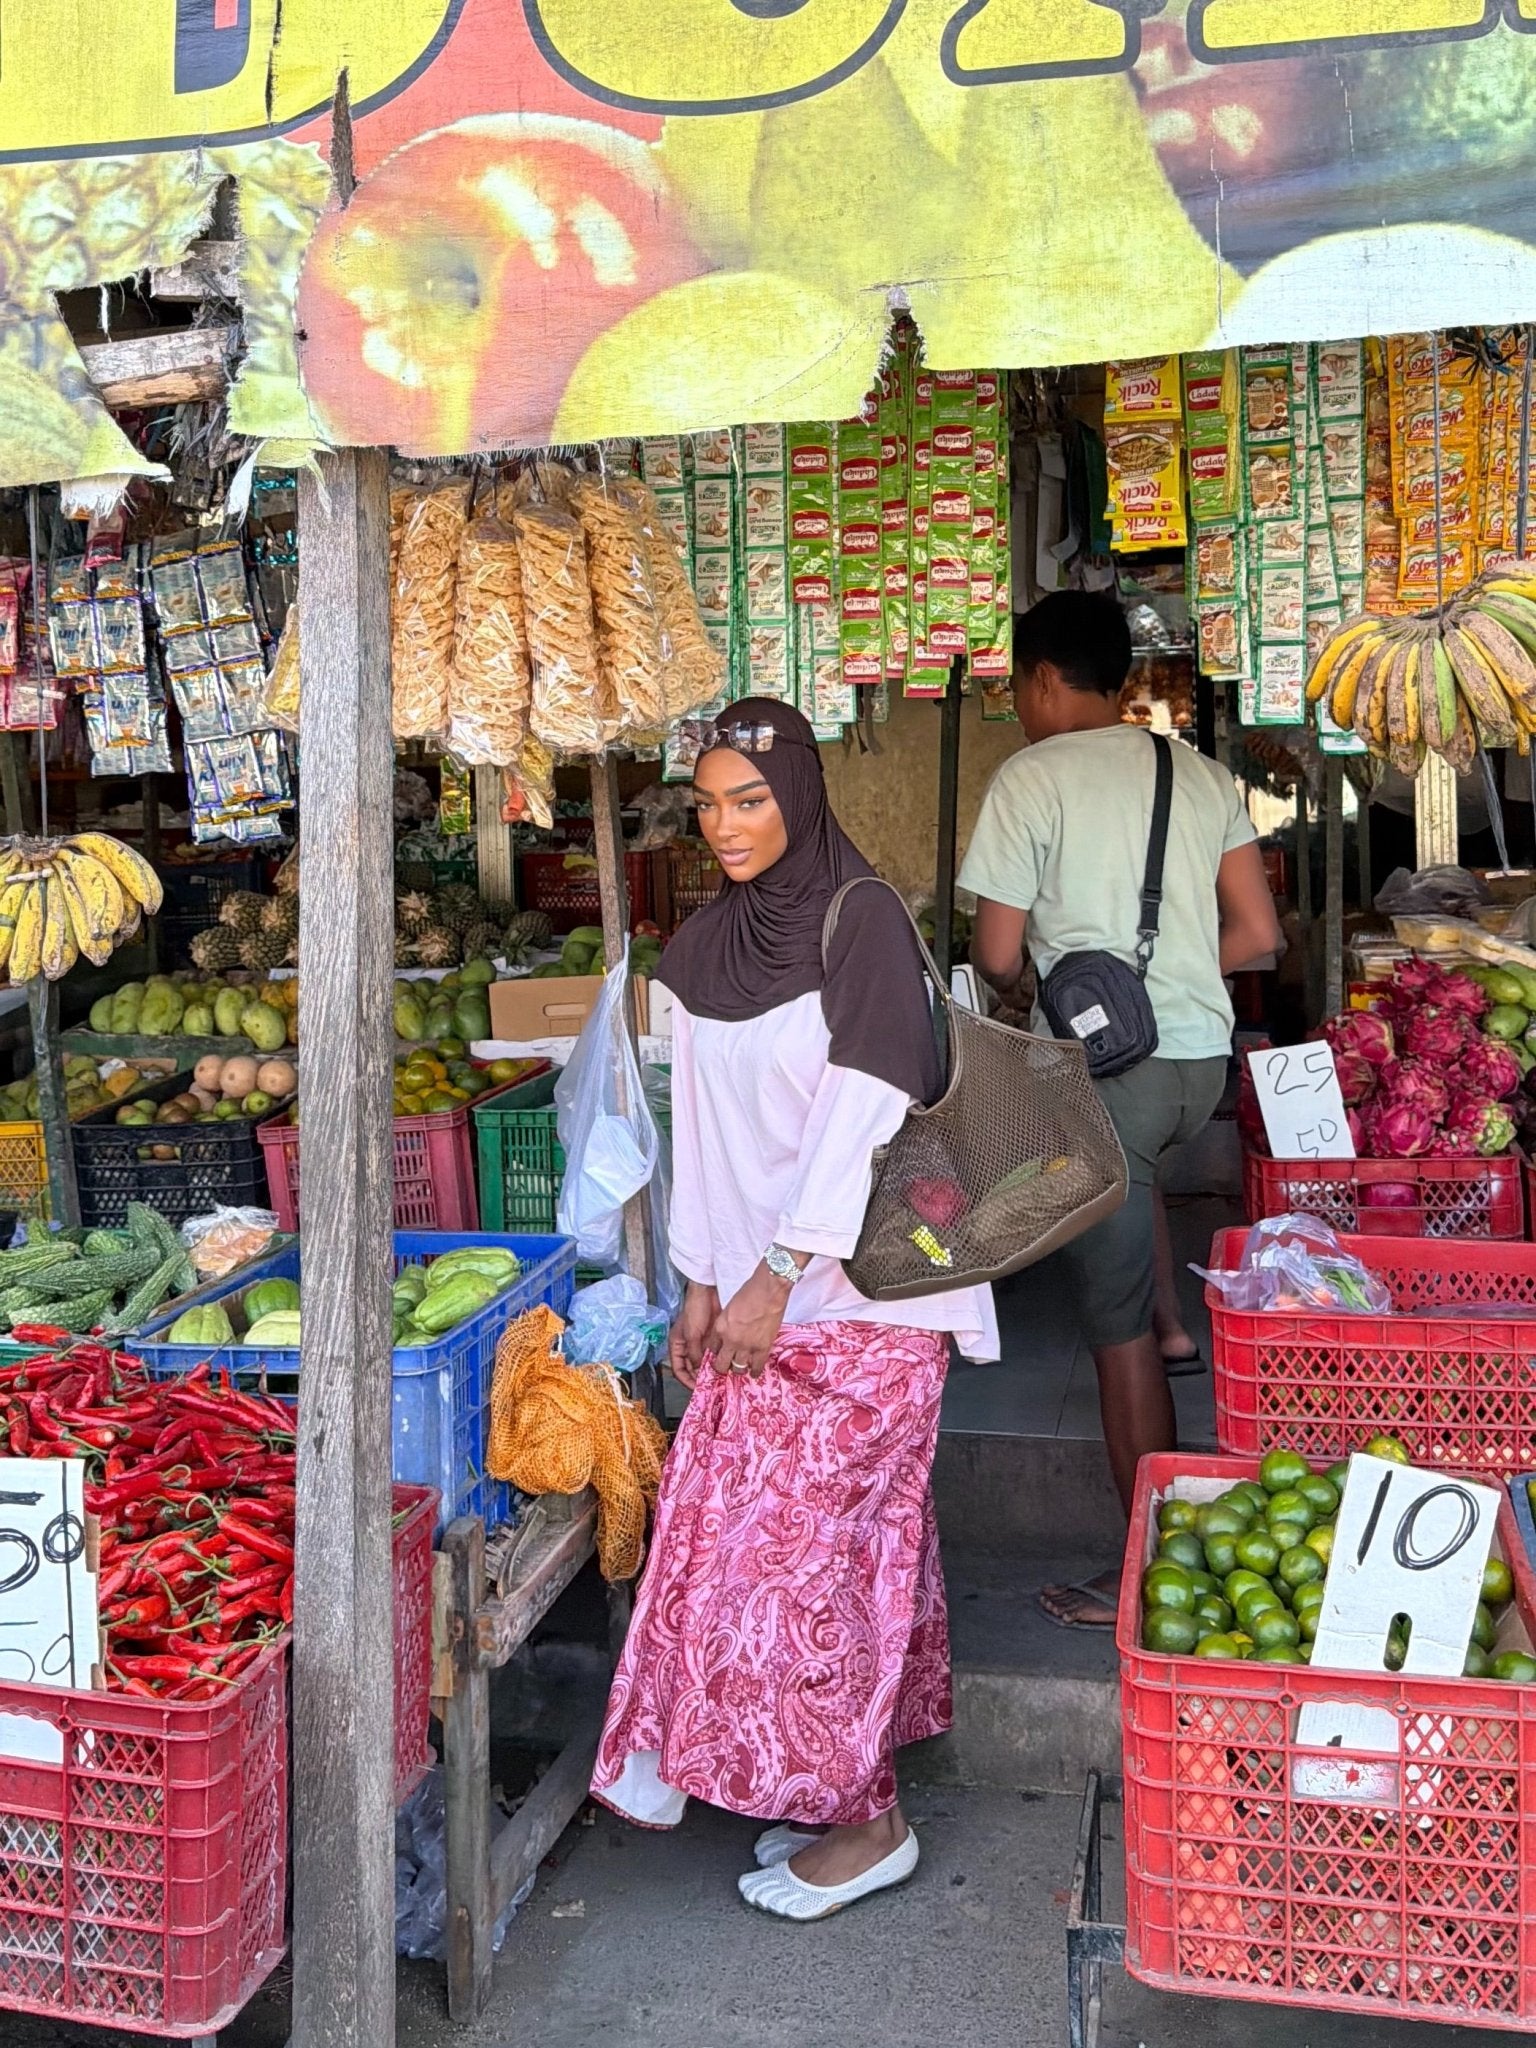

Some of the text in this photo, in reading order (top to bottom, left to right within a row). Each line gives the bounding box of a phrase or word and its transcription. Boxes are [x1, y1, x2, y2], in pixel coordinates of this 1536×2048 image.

[1117, 378, 1161, 403] Racik
[933, 433, 968, 447] Ladaku
[796, 453, 826, 468] Ladaku
[844, 467, 875, 483] Ladaku
[1117, 482, 1161, 504] Racik
[1124, 516, 1168, 533] Racik
[844, 532, 875, 547] Ladaku
[1266, 1050, 1334, 1096] 25
[1296, 1118, 1338, 1159] 50
[1356, 1469, 1480, 1571] 10
